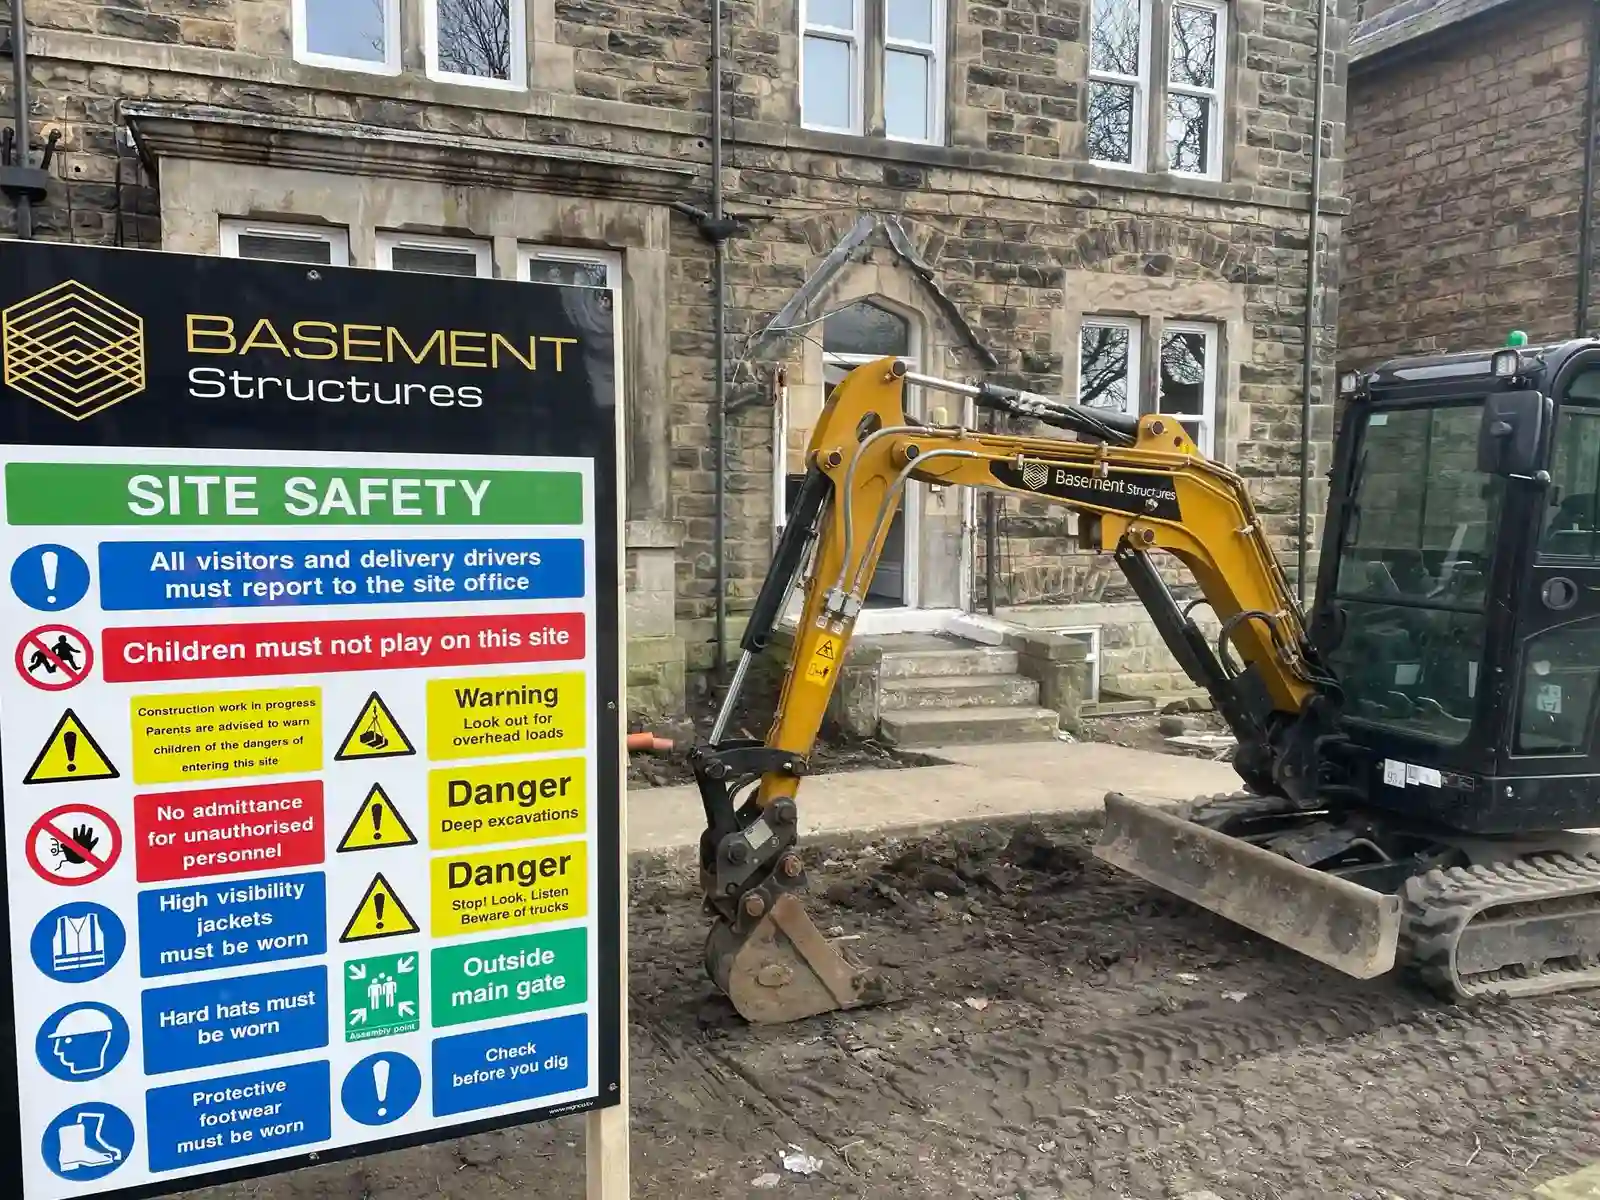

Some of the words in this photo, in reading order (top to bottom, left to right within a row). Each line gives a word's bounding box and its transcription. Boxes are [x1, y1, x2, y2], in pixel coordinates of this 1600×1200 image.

[186, 313, 578, 372] BASEMENT
[188, 367, 483, 408] Structures
[127, 475, 259, 517] SITE
[284, 477, 491, 517] SAFETY
[1055, 469, 1125, 494] Basement
[1127, 483, 1176, 501] Structures
[151, 551, 185, 571] All
[196, 550, 294, 571] visitors
[304, 549, 350, 569] and
[360, 549, 454, 571] delivery
[463, 548, 542, 567] drivers
[166, 579, 232, 599] must
[242, 577, 323, 600] report
[332, 576, 357, 595] to
[366, 575, 405, 594] the
[413, 574, 455, 592] site
[464, 573, 529, 591] office
[123, 641, 246, 664] Children
[255, 636, 322, 658] must
[331, 634, 372, 655] not
[380, 632, 432, 657] play
[440, 632, 471, 650] on
[478, 628, 522, 648] this
[528, 627, 570, 646] site
[138, 704, 215, 717] Construction
[219, 702, 247, 712] work
[251, 701, 262, 710] in
[265, 699, 316, 712] progress
[454, 685, 559, 708] Warning
[146, 724, 191, 736] Parents
[195, 724, 214, 733] are
[218, 719, 264, 731] advised
[267, 719, 279, 728] to
[282, 718, 310, 727] warn
[464, 716, 500, 730] Look
[505, 715, 529, 727] out
[533, 713, 553, 725] for
[153, 744, 201, 755] children
[205, 742, 217, 752] of
[221, 740, 239, 750] the
[243, 738, 289, 749] dangers
[292, 736, 304, 745] of
[453, 730, 521, 746] overhead
[526, 728, 564, 741] loads
[182, 760, 229, 772] entering
[233, 758, 255, 768] this
[258, 756, 279, 766] site
[448, 775, 572, 808] Danger
[157, 805, 185, 821] No
[192, 796, 303, 819] admittance
[441, 819, 483, 833] Deep
[488, 808, 579, 827] excavations
[147, 831, 177, 847] for
[184, 816, 314, 844] unauthorised
[183, 842, 282, 870] personnel
[448, 854, 572, 890] Danger
[159, 891, 209, 913] High
[216, 881, 305, 905] visibility
[452, 896, 487, 911] Stop!
[531, 887, 569, 900] Listen
[196, 910, 273, 938] jackets
[461, 911, 510, 925] Beware
[514, 906, 526, 917] of
[530, 901, 569, 915] trucks
[160, 943, 215, 965] must
[222, 940, 249, 956] be
[256, 933, 309, 951] worn
[463, 947, 555, 977] Outside
[451, 981, 509, 1007] main
[516, 973, 566, 1001] gate
[159, 1005, 210, 1028] Hard
[216, 1000, 260, 1020] hats
[266, 990, 316, 1012] must
[198, 1028, 224, 1045] be
[230, 1020, 280, 1040] worn
[349, 1027, 391, 1041] Assembly
[393, 1023, 416, 1034] point
[485, 1041, 537, 1062] Check
[452, 1068, 505, 1087] before
[510, 1061, 539, 1080] you
[544, 1055, 569, 1071] dig
[192, 1080, 287, 1107] Protective
[200, 1101, 282, 1128] footwear
[176, 1133, 224, 1154] must
[230, 1130, 253, 1144] be
[259, 1120, 305, 1139] worn
